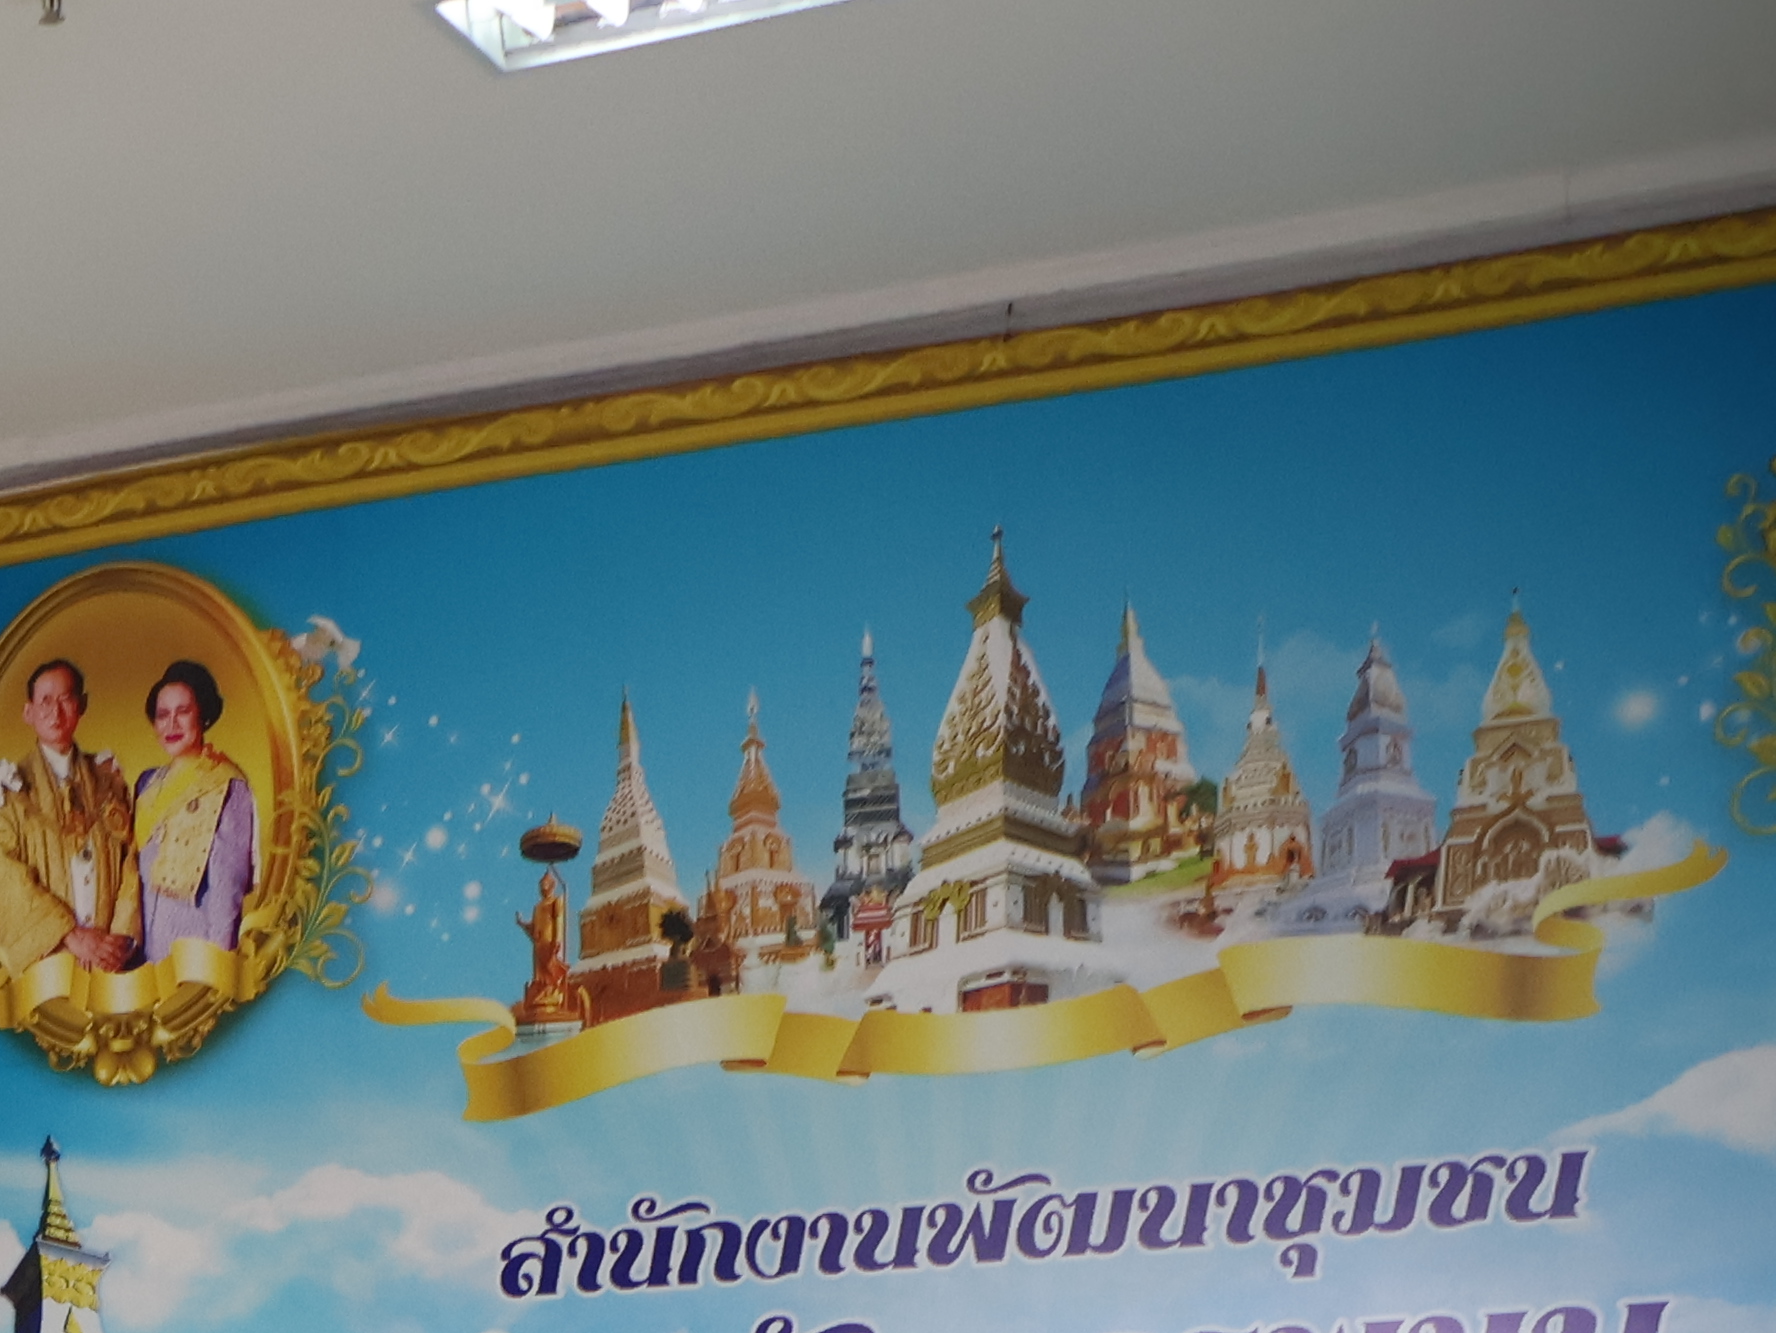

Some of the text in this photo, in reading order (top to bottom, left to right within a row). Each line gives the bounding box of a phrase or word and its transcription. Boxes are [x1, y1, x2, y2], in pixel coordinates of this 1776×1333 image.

[499, 1149, 1591, 1298] สำนักงานพัฒนาชุมชน
